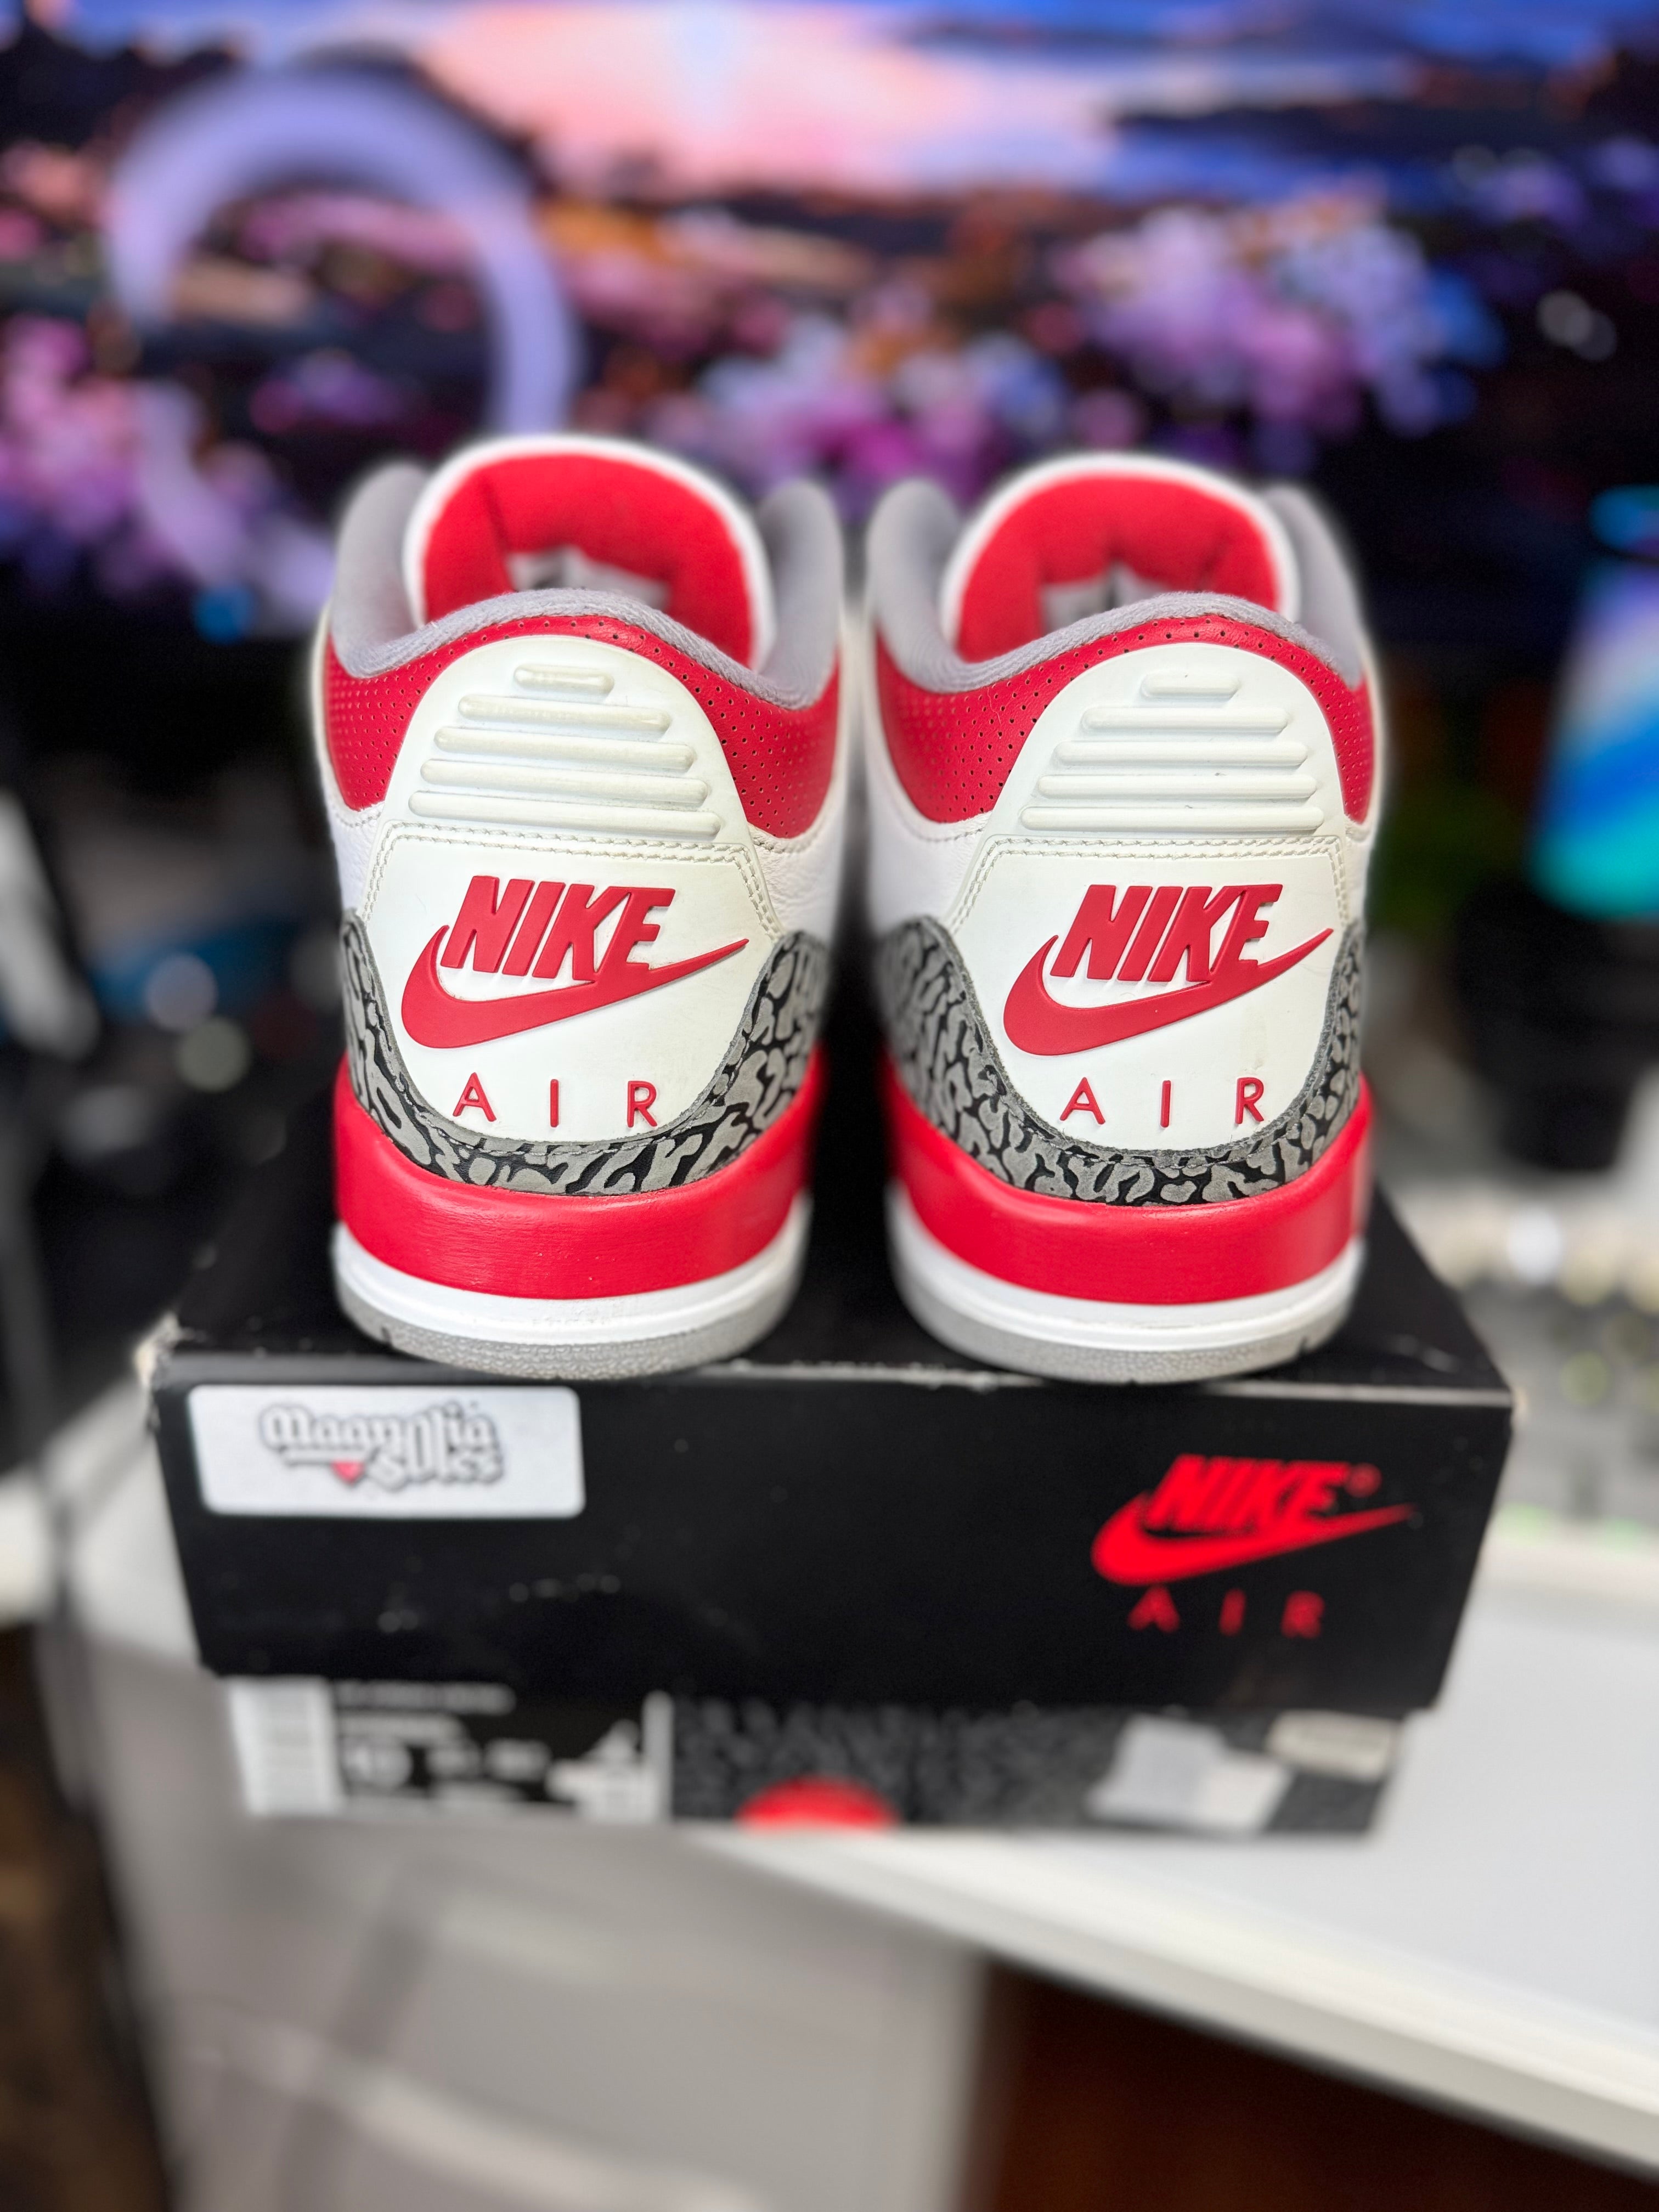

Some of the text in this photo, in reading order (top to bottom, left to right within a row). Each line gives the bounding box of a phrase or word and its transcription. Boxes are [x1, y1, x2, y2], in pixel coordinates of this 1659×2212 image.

[440, 875, 676, 982] NIKE
[1049, 883, 1284, 983] NIKE
[452, 1072, 658, 1128] AIR
[1059, 1076, 1265, 1128] AIR
[1141, 1453, 1351, 1532] NIKE
[1127, 1584, 1326, 1639] AIR
